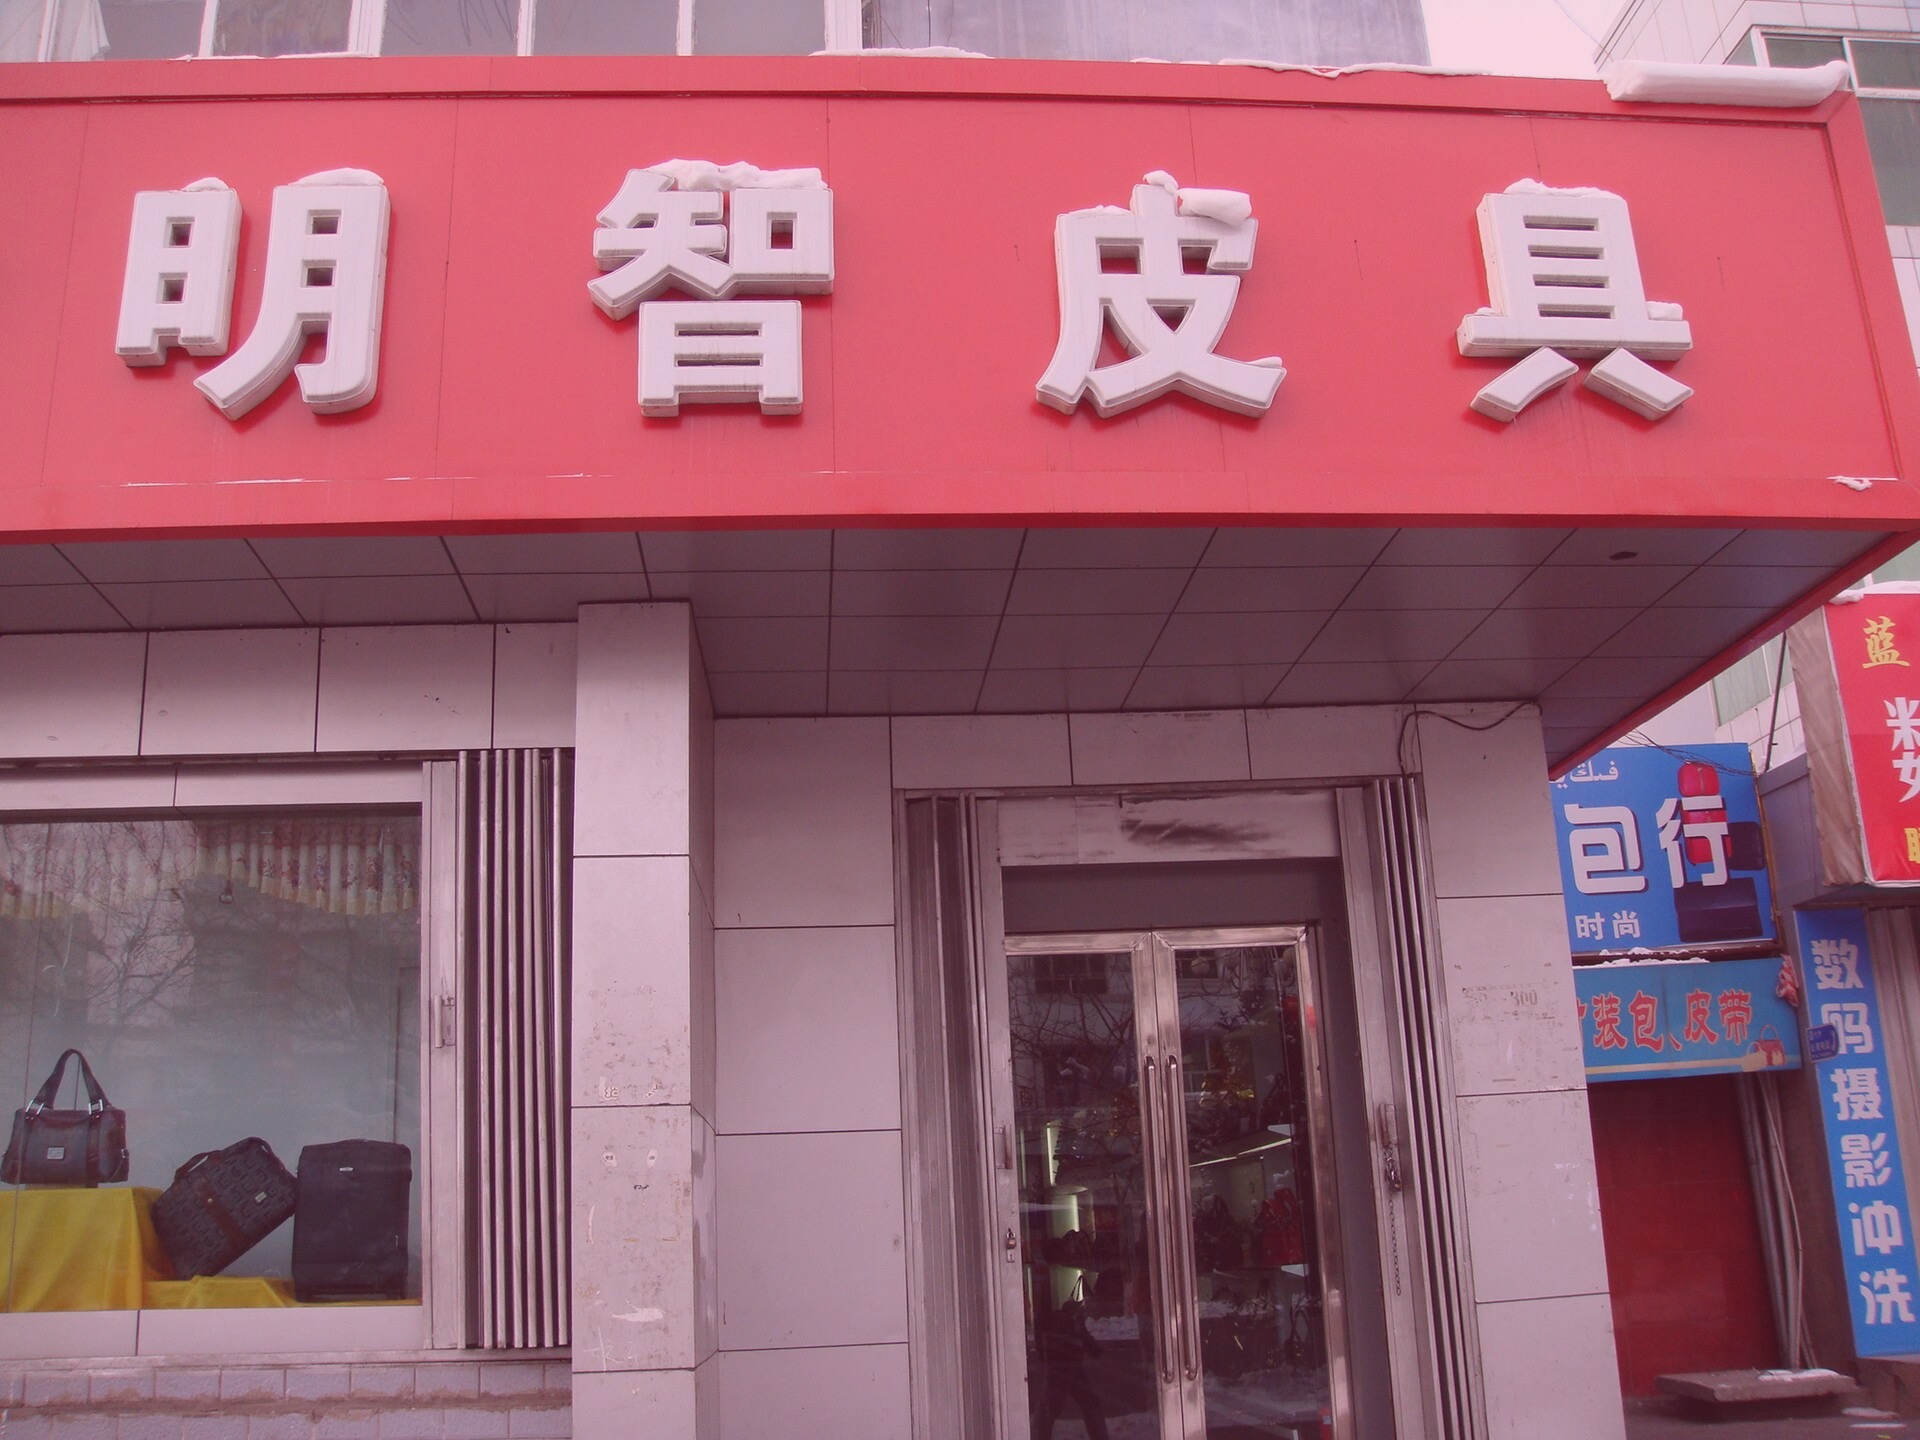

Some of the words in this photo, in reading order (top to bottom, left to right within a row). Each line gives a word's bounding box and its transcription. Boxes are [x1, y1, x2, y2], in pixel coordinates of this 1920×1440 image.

[114, 165, 1696, 421] 明智皮具
[1861, 616, 1911, 669] 蓝
[1563, 794, 1729, 894] 包行
[1574, 910, 1641, 941] 时尚
[1810, 937, 1917, 1325] 数码摄影冲洗
